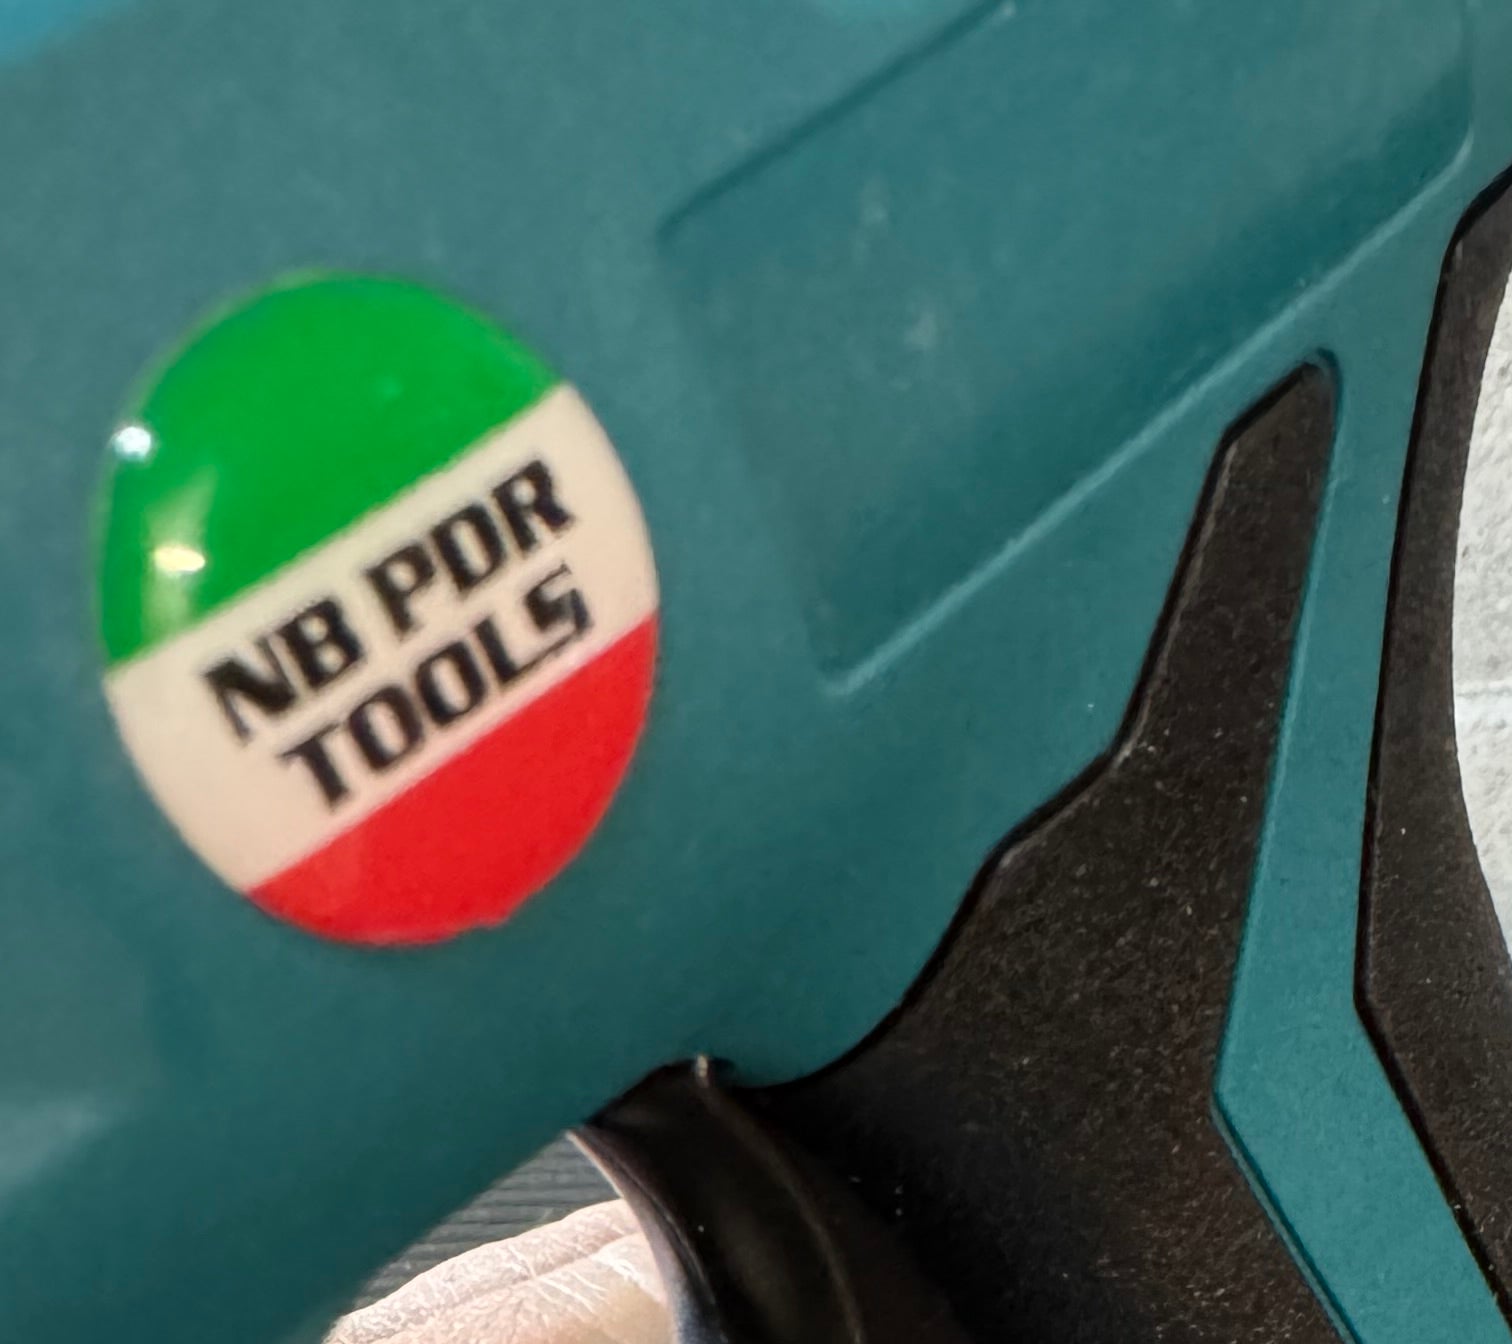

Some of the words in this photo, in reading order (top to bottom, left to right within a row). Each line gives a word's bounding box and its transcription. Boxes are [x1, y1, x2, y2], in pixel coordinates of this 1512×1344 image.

[203, 596, 365, 743] NB
[364, 460, 574, 638] PDR
[280, 564, 593, 810] TOOLS
